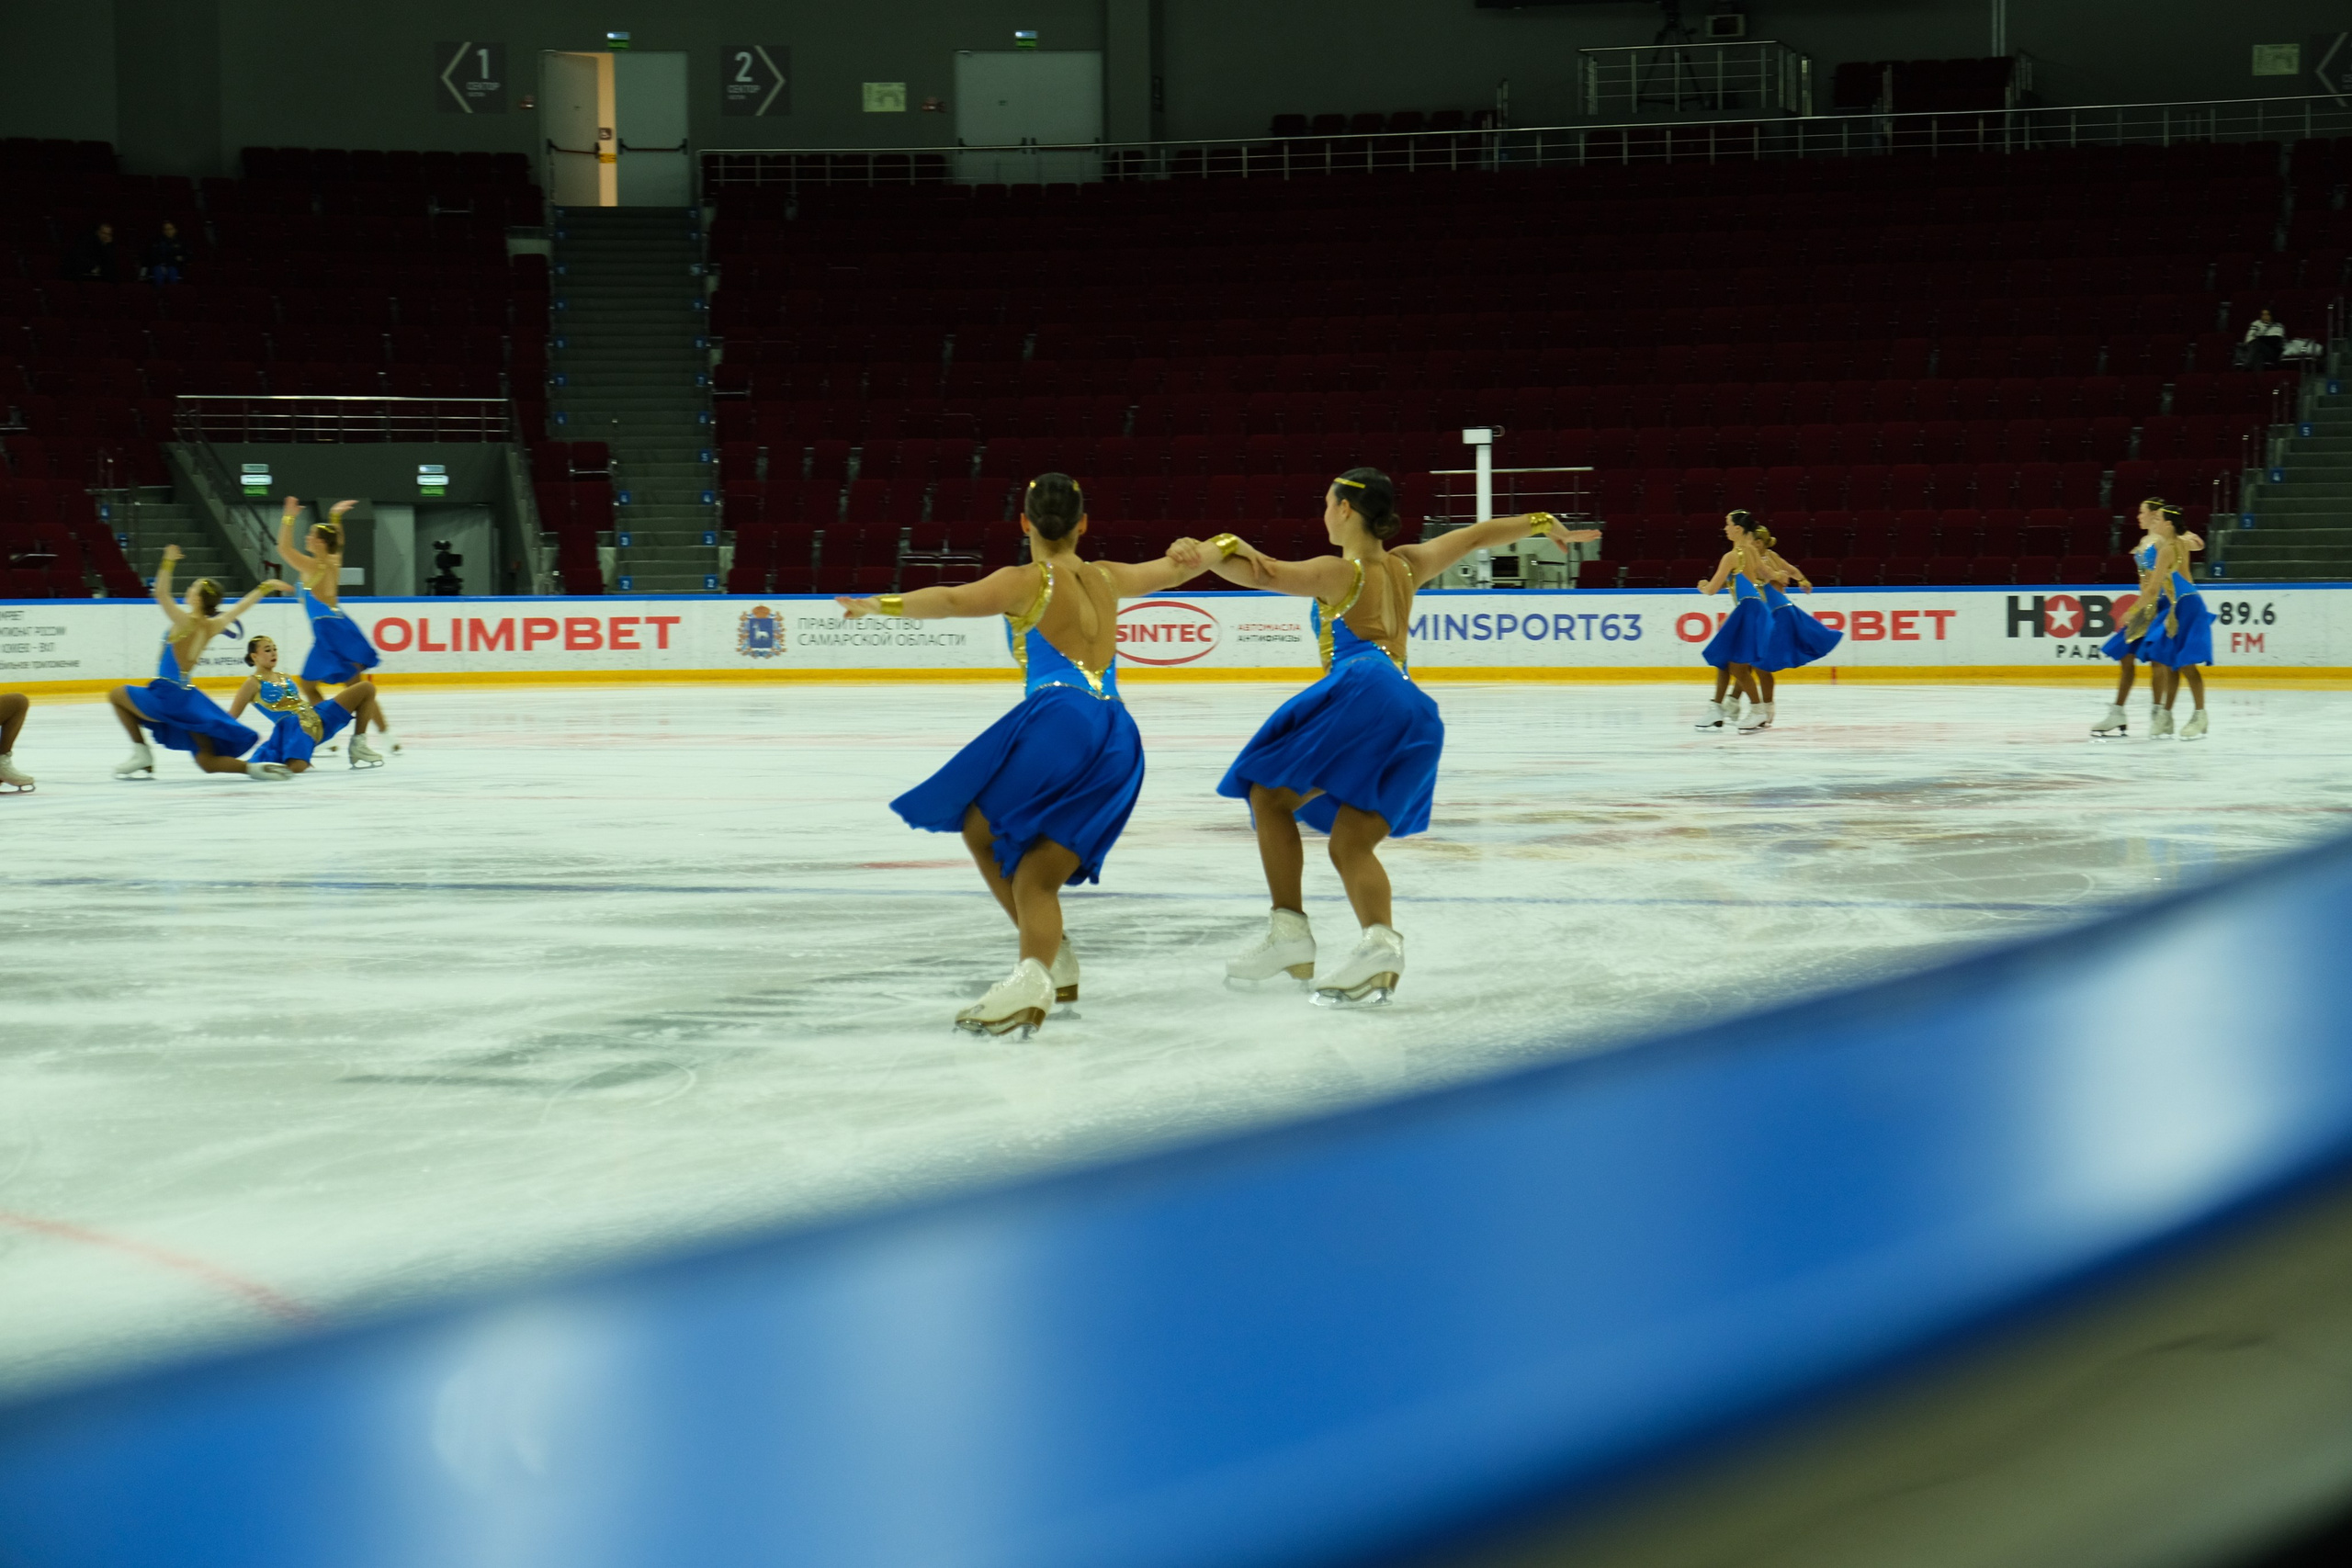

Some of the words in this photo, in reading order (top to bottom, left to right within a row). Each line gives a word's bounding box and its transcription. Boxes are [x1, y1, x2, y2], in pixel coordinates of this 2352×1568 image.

[477, 49, 489, 80] 1
[735, 51, 752, 82] 2
[797, 617, 923, 630] ПРАВИТЕЛЬСТВО
[1675, 610, 1956, 643] OPBET
[2220, 601, 2276, 626] 89.6
[373, 616, 682, 652] OLIMPBET
[797, 632, 893, 646] САМАРСКОЙ
[895, 633, 967, 646] ОБЛАСТИ
[1115, 624, 1213, 643] SINTEC
[1408, 613, 1643, 641] MINSPORT63
[2231, 632, 2266, 653] FM
